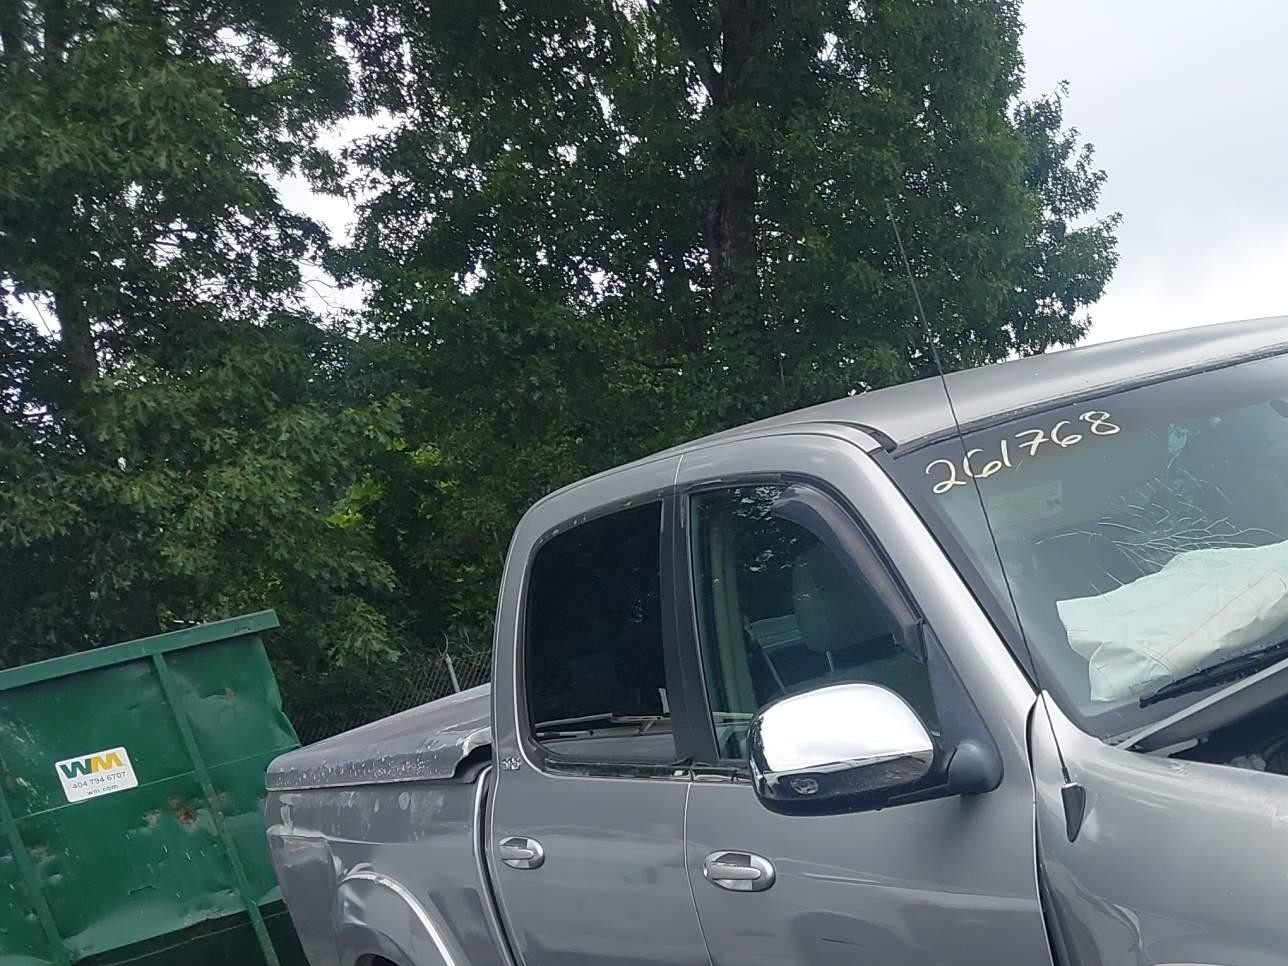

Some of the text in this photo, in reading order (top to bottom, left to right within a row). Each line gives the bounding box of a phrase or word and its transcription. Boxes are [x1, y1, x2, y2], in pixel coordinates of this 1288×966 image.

[925, 411, 1121, 494] 261768
[60, 752, 123, 779] WM
[72, 780, 88, 790] 404
[89, 776, 105, 785] 794
